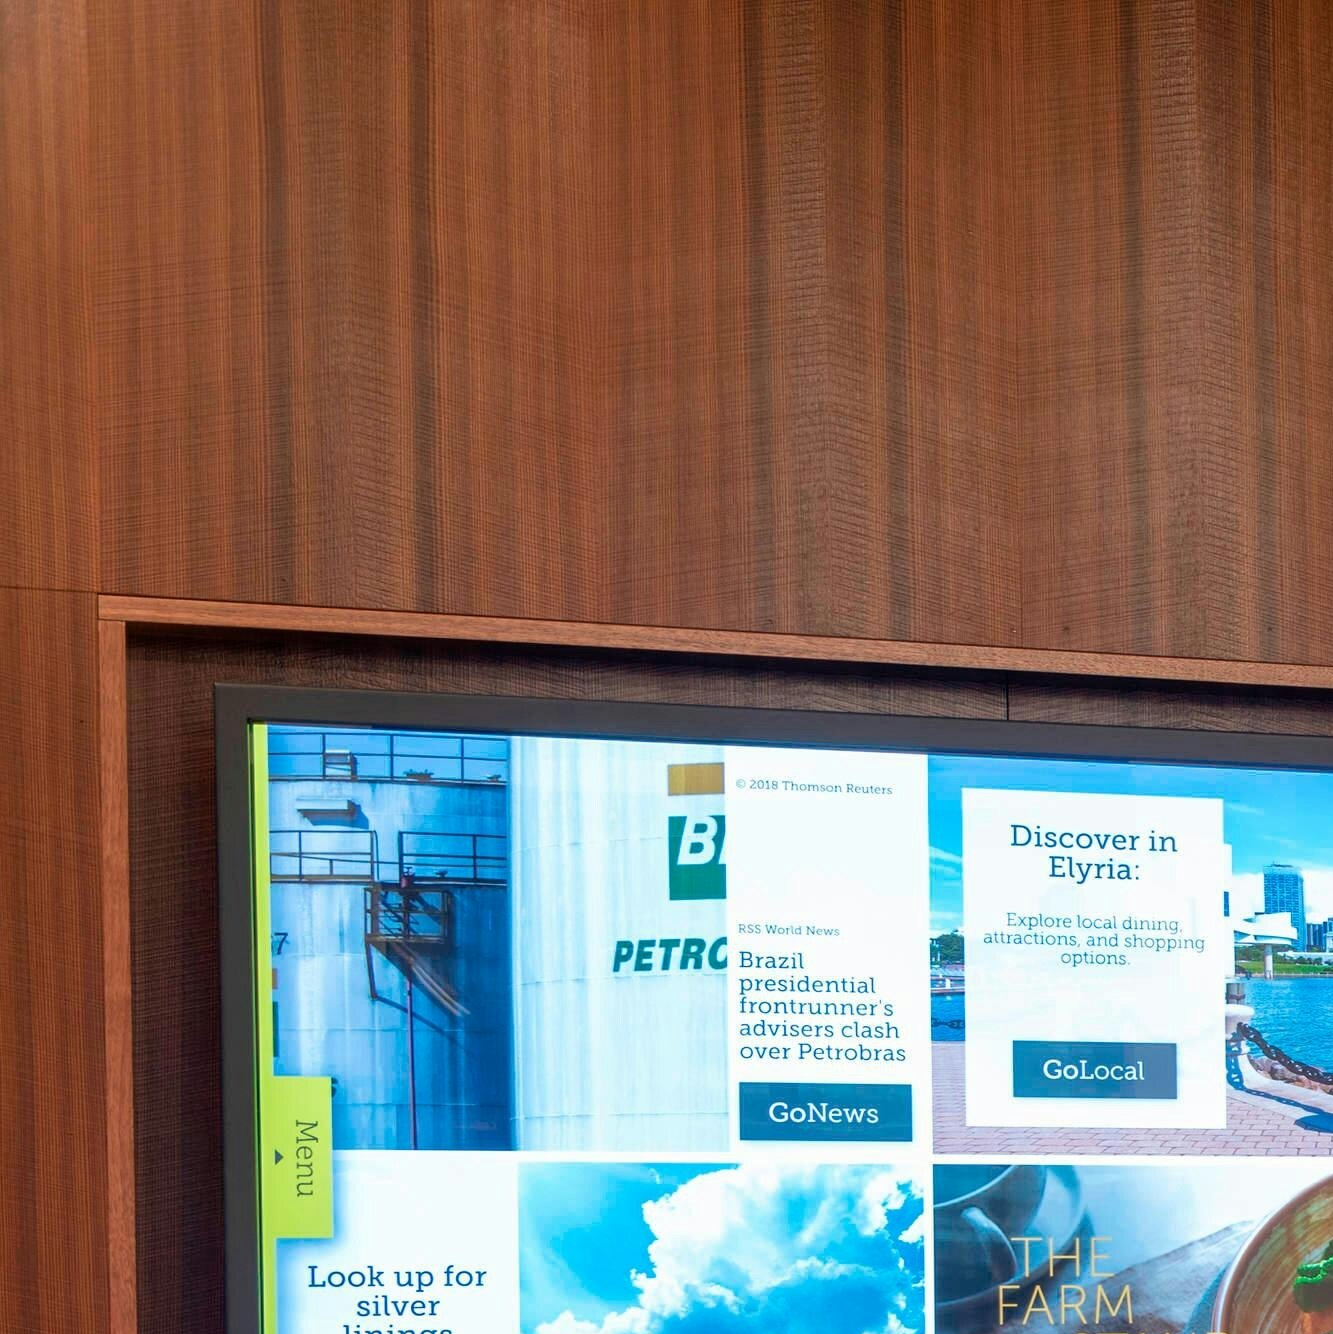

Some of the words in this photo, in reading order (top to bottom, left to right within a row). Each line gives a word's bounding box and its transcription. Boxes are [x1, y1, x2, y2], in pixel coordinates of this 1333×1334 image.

[749, 779, 779, 791] 2018
[782, 780, 842, 793] Thomson
[846, 783, 893, 795] Reuters
[677, 815, 729, 866] B
[1010, 824, 1140, 851] Discover
[1149, 830, 1178, 852] in
[1049, 855, 1140, 884] Elyria:
[738, 923, 762, 935] RSS
[765, 923, 802, 936] World
[805, 925, 840, 937] News
[1006, 912, 1072, 931] Explore
[1076, 914, 1117, 930] local
[1122, 916, 1183, 935] dining,
[983, 932, 1081, 948] attractions,
[1086, 934, 1119, 948] and
[1124, 936, 1205, 952] shopping
[739, 951, 805, 970] Brazil
[1060, 951, 1131, 968] options.
[739, 976, 876, 995] presidential
[739, 997, 894, 1017] frontrunner's
[739, 1019, 834, 1038] advisers
[841, 1021, 900, 1039] clash
[739, 1046, 791, 1060] over
[798, 1042, 906, 1062] Petrobras
[1042, 1058, 1145, 1081] GoLocal
[768, 1101, 879, 1124] GoNews
[295, 1119, 319, 1198] Menu
[1010, 1236, 1115, 1278] THE
[307, 1265, 385, 1288] Look
[394, 1270, 434, 1292] up
[443, 1264, 488, 1288] for
[356, 1295, 441, 1317] silver
[998, 1284, 1134, 1325] FARM
